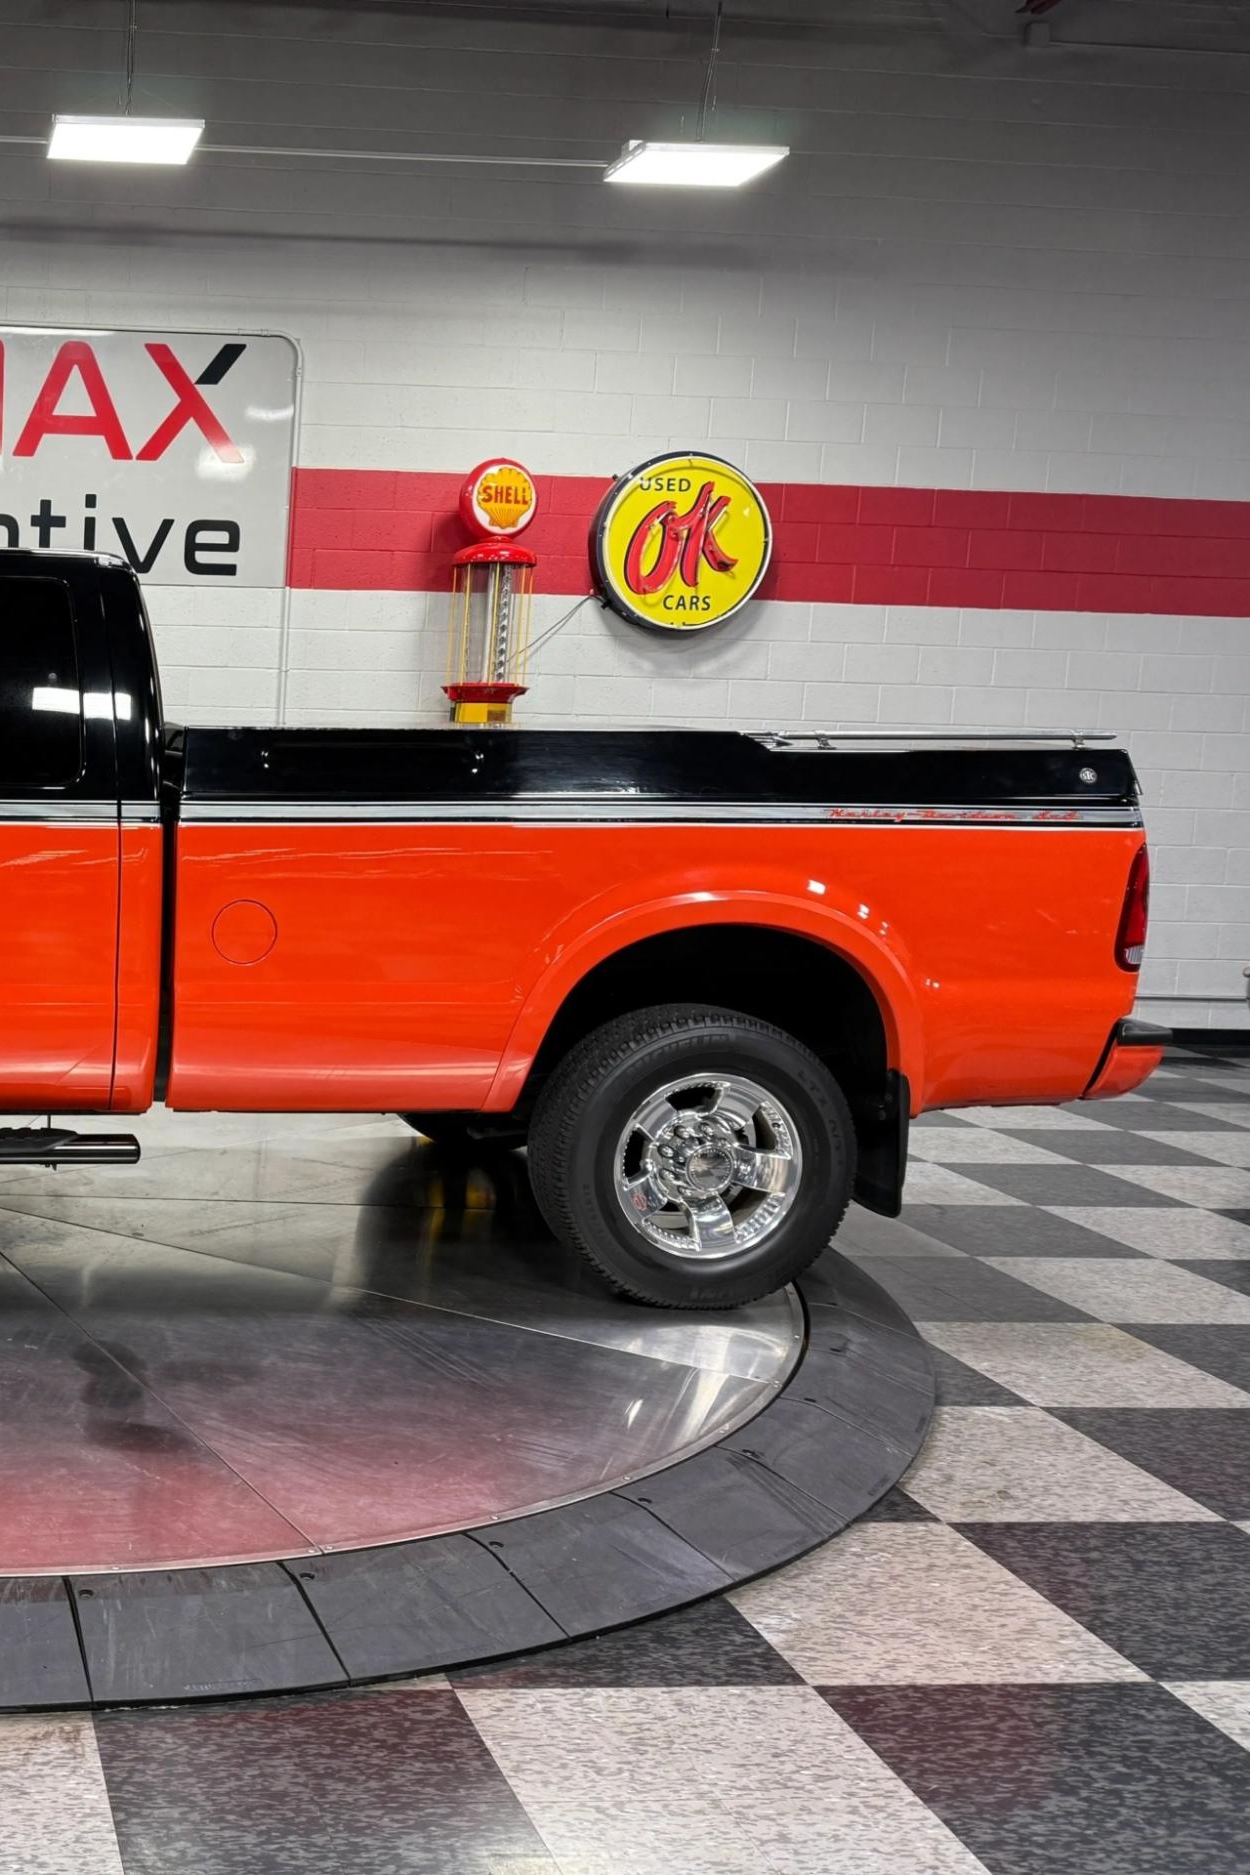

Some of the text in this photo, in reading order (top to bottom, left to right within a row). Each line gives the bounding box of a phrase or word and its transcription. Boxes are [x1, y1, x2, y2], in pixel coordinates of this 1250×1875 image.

[640, 477, 692, 493] USED
[481, 484, 530, 506] SHELL
[662, 594, 712, 612] CARS
